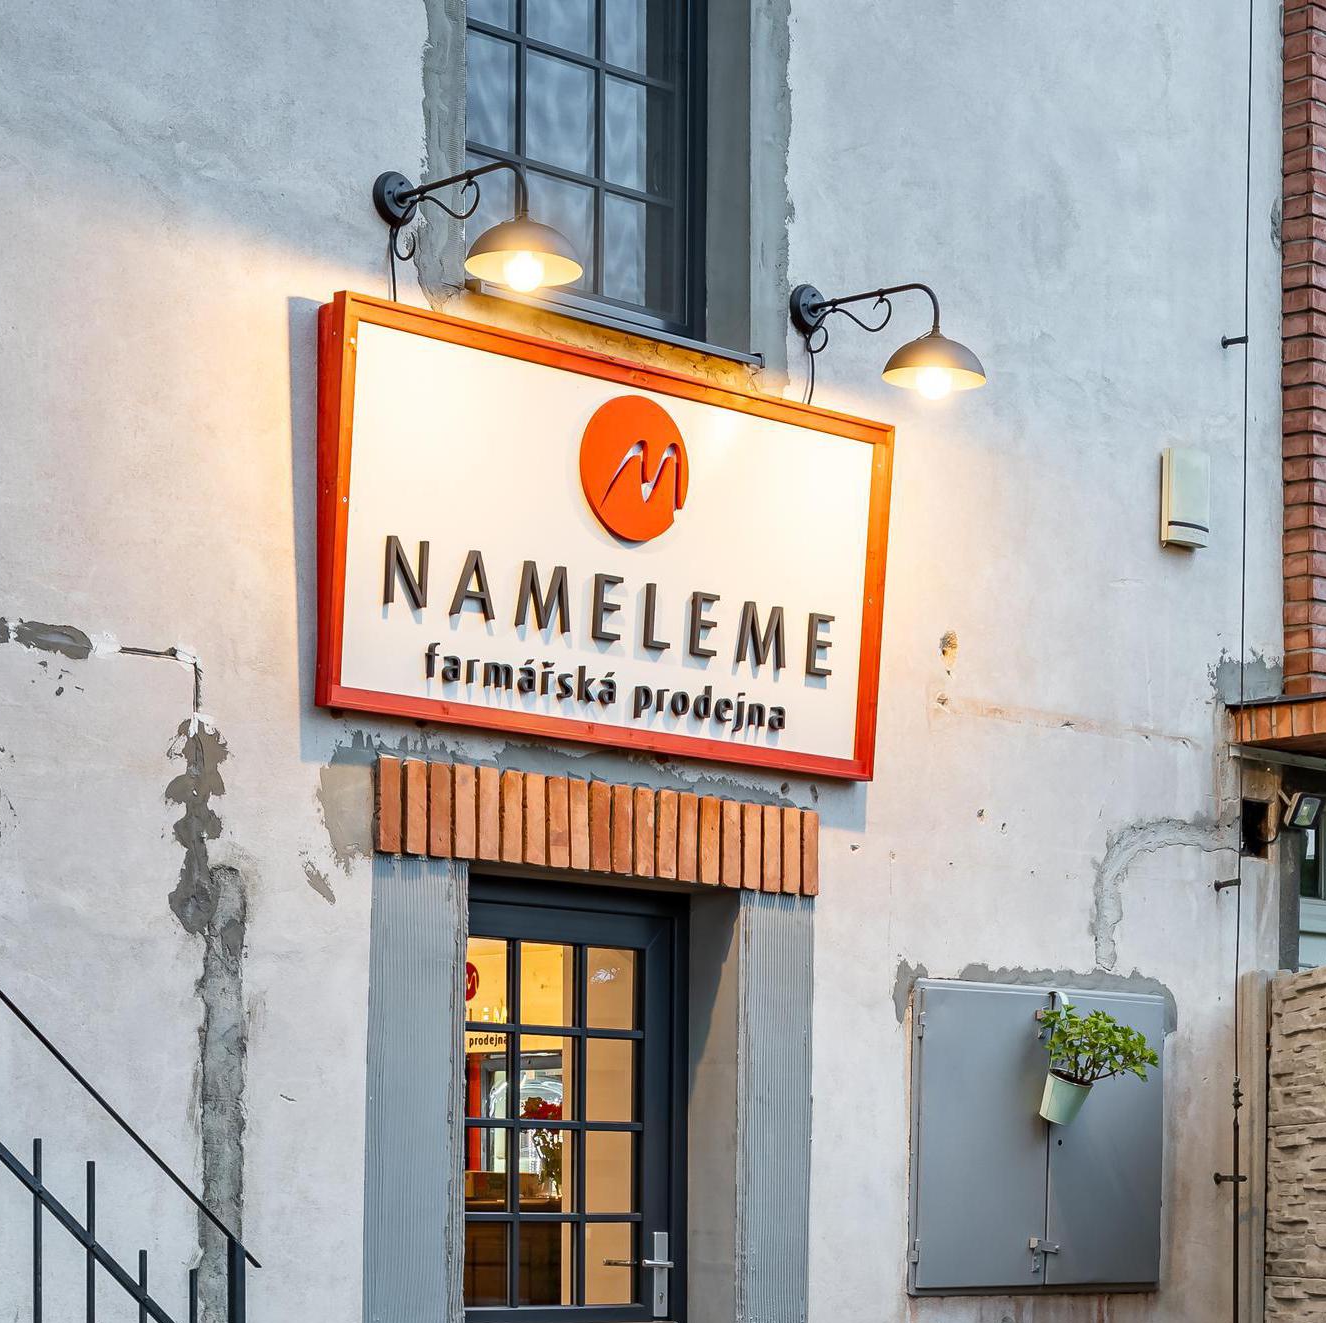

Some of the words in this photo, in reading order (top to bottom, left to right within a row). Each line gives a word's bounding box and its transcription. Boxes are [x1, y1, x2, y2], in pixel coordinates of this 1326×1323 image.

[383, 535, 836, 677] NAMELEME
[424, 642, 617, 704] farmářská
[633, 685, 787, 732] prodejna
